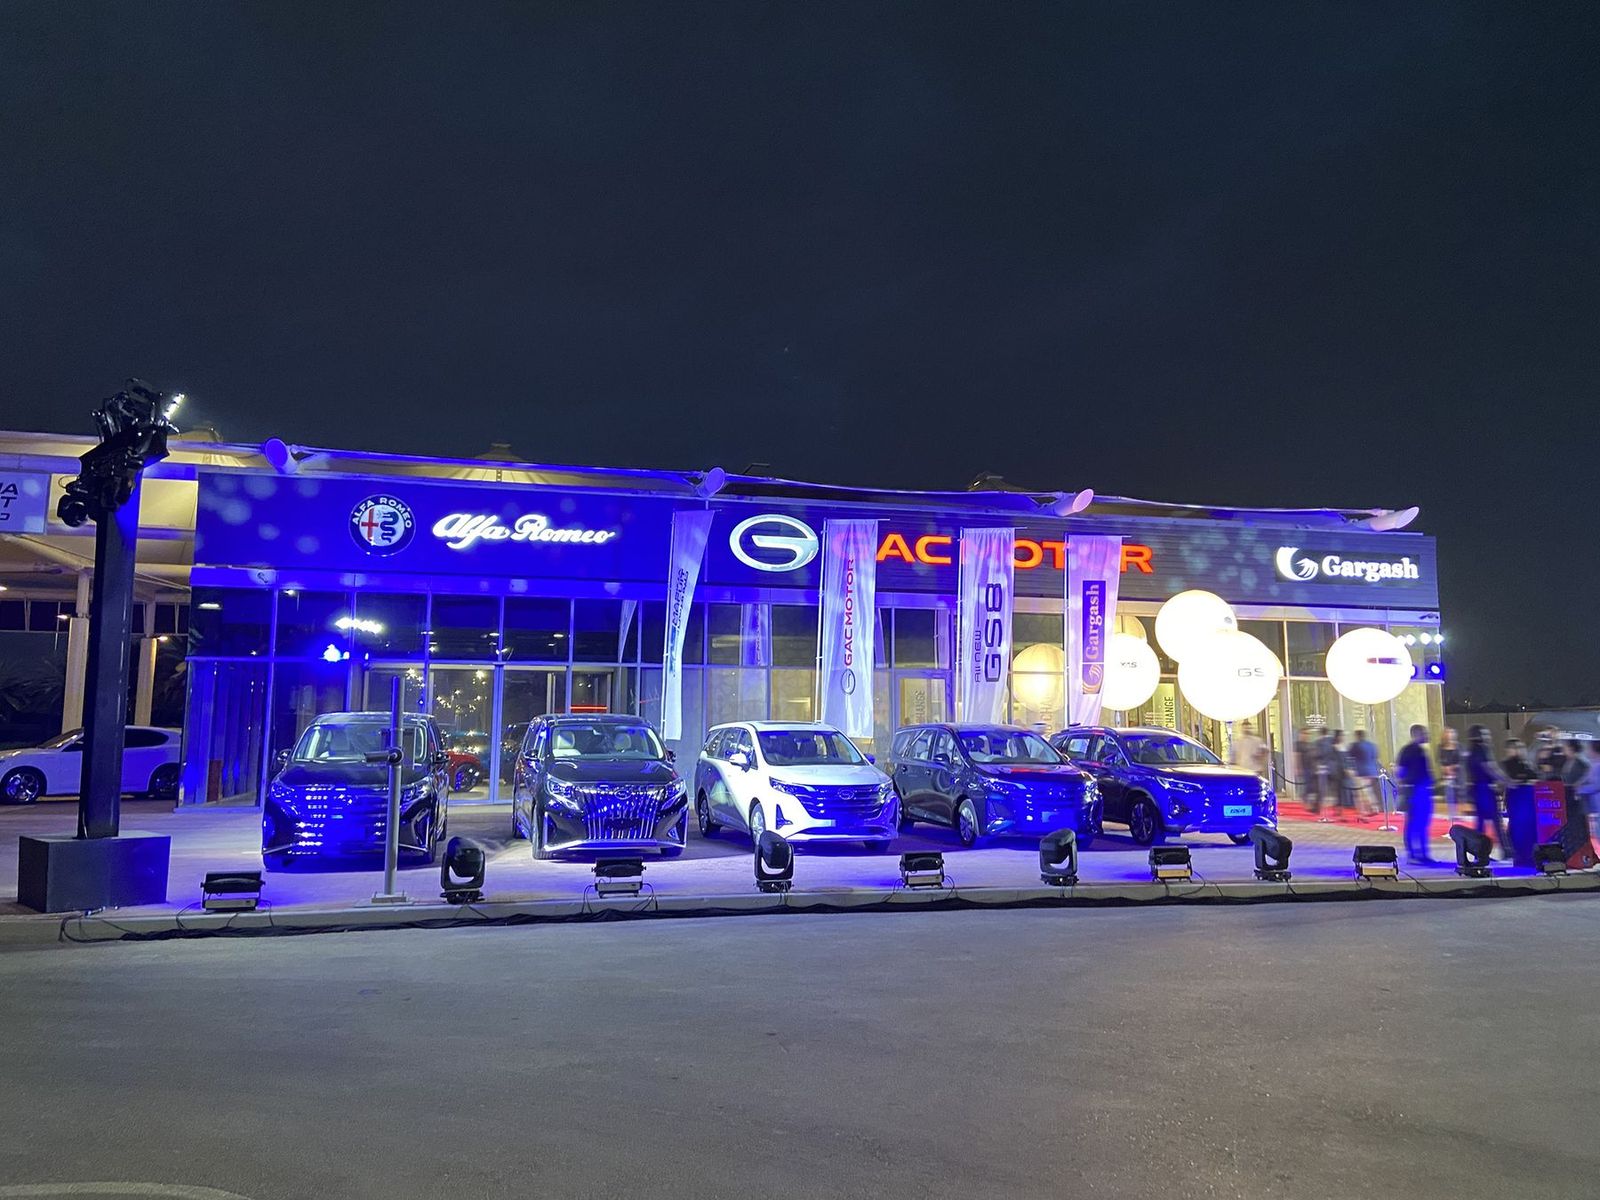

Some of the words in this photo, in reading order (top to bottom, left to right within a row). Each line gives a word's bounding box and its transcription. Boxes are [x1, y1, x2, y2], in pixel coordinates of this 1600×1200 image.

[352, 500, 375, 525] ALFA
[380, 497, 412, 528] ROMEO
[432, 513, 511, 549] Alfa
[510, 513, 615, 544] Romeo
[1322, 555, 1419, 582] Gargash
[985, 583, 1002, 682] GS8
[1086, 584, 1102, 660] Gargash
[1164, 697, 1174, 729] CHANGE
